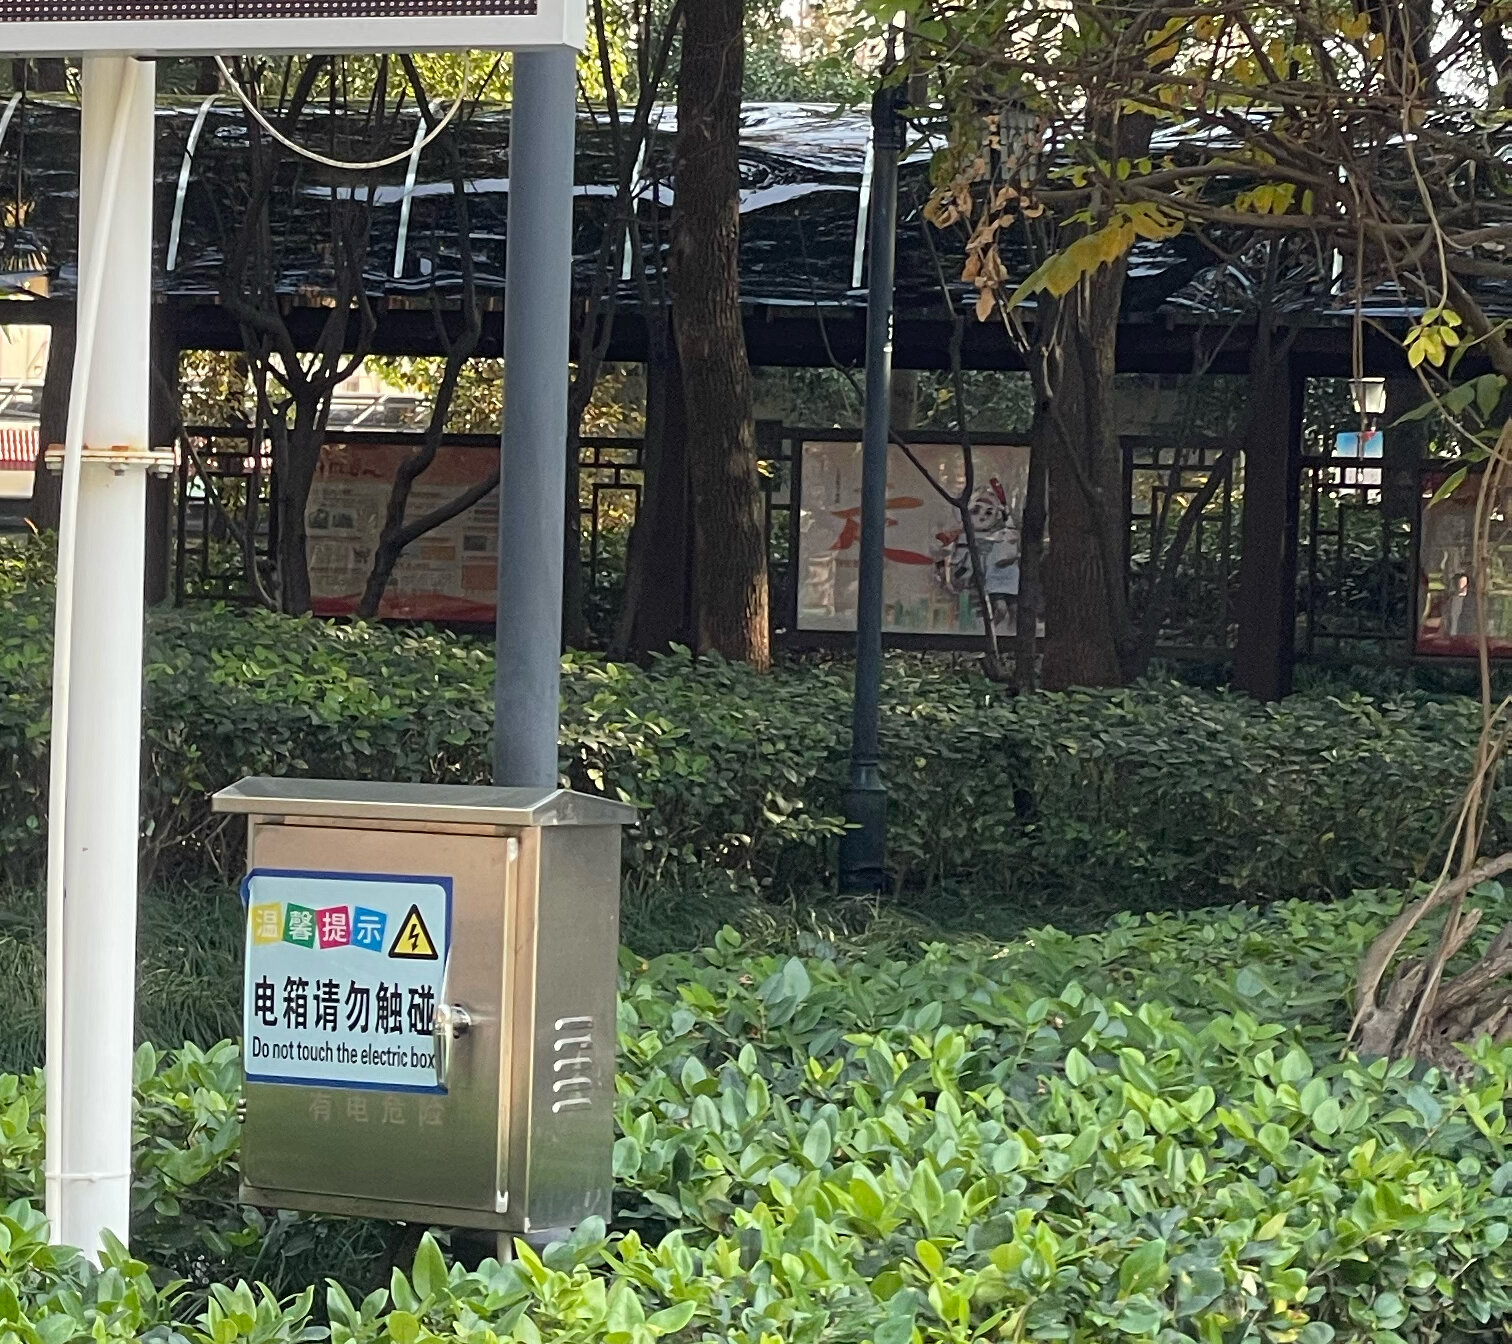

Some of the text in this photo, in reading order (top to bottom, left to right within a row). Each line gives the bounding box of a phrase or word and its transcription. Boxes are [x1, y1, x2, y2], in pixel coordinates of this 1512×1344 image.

[256, 909, 382, 945] 温馨提示
[254, 974, 435, 1036] 电箱请勿触碰
[252, 1035, 435, 1069] Do not touch the electric box
